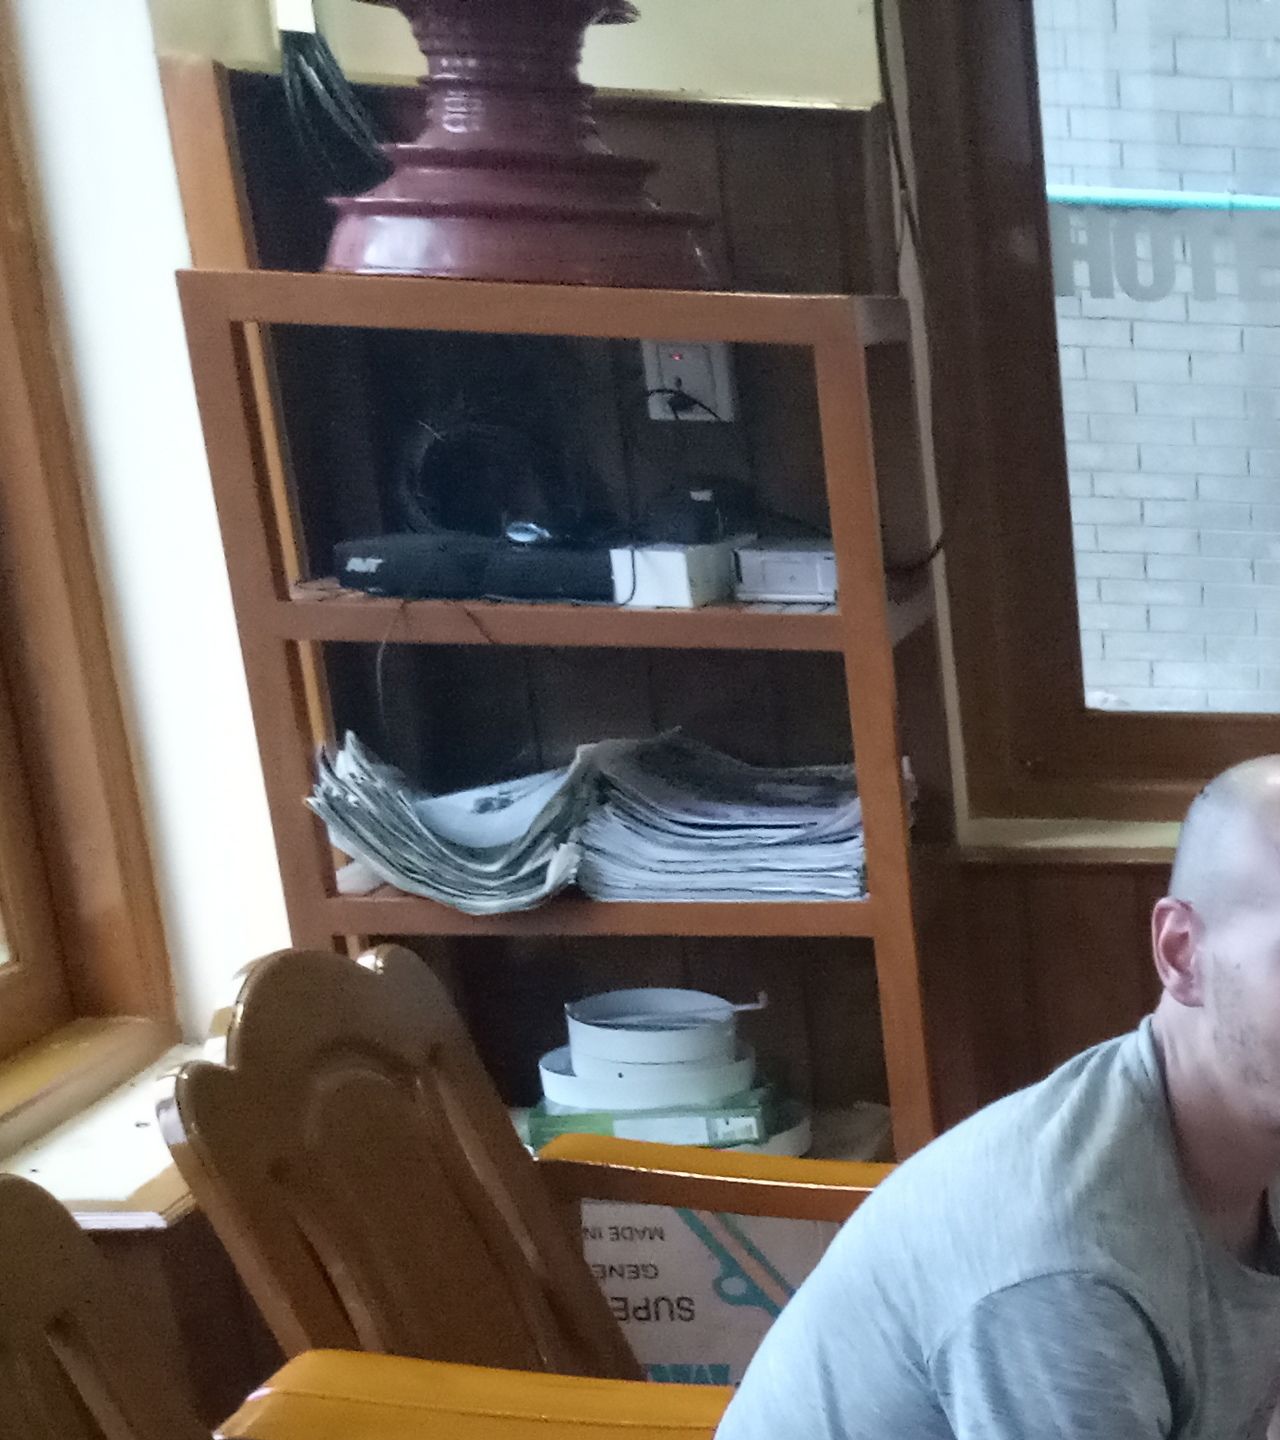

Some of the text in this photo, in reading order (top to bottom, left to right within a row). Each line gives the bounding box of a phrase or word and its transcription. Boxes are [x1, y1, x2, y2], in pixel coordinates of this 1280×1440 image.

[609, 1226, 665, 1242] MADE
[592, 1263, 659, 1280] GENE
[610, 1295, 696, 1322] SUPE
